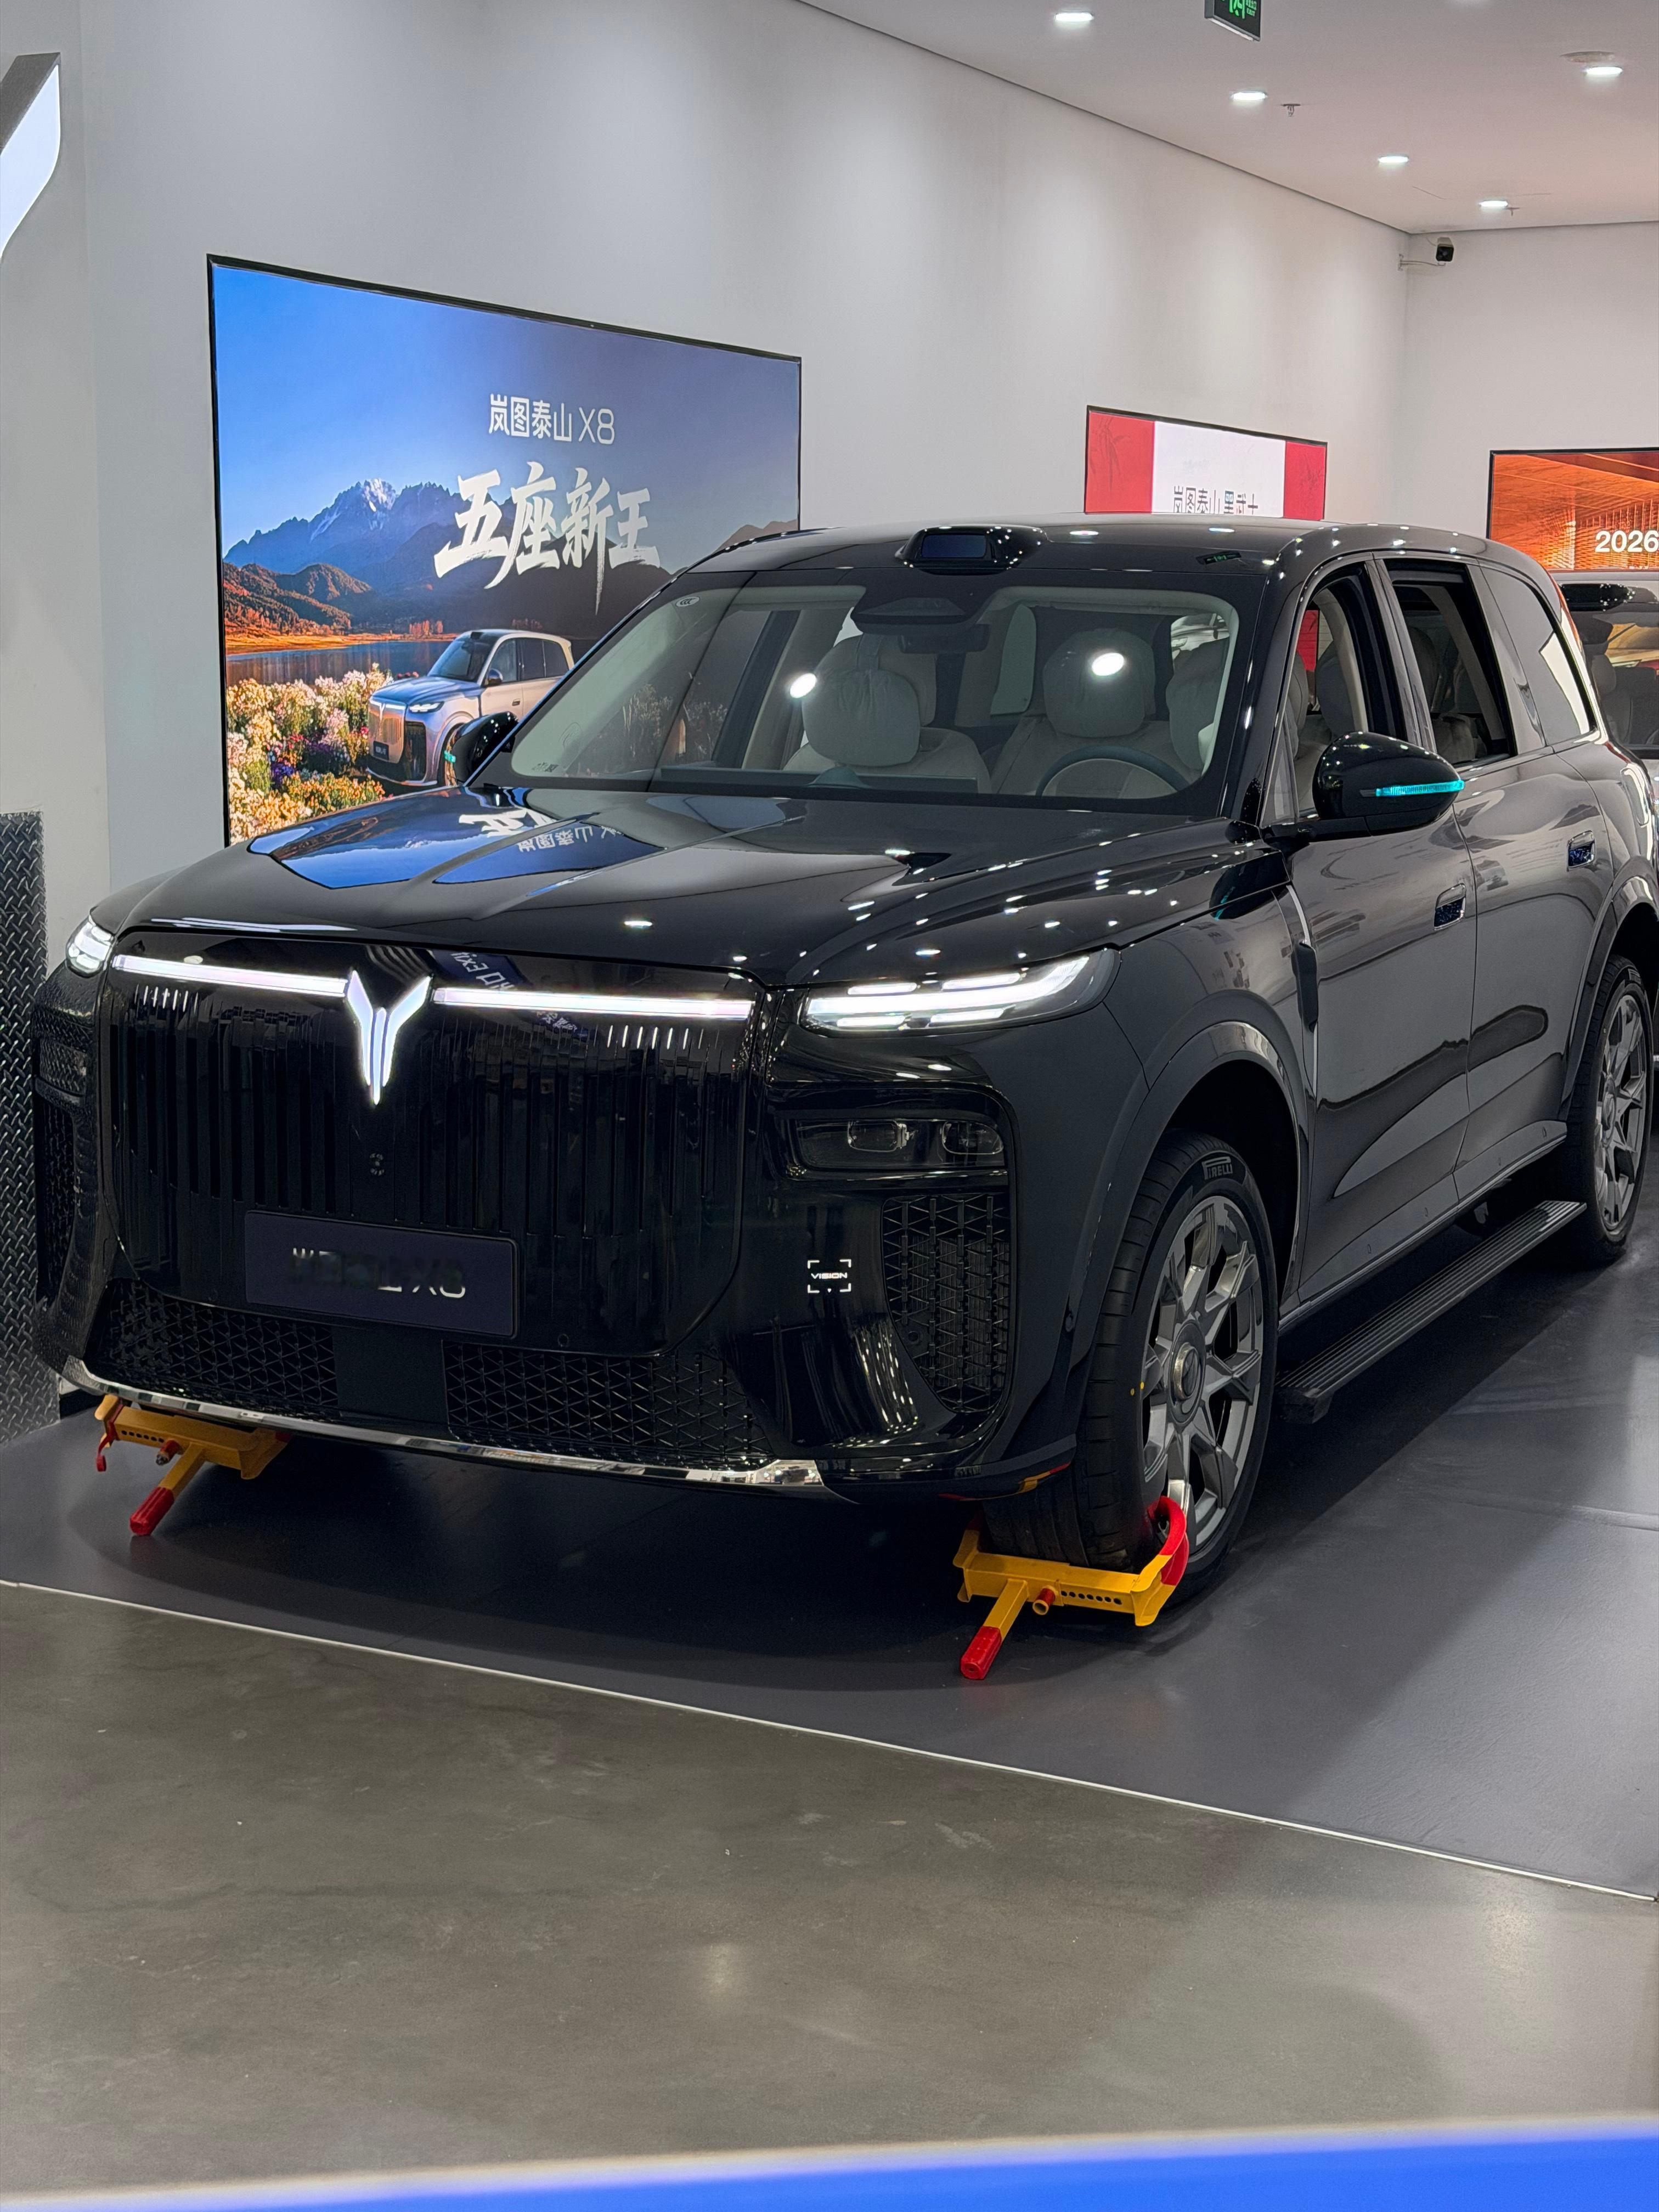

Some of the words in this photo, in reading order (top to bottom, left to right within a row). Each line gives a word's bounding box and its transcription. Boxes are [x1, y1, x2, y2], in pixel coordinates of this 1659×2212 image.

[488, 393, 572, 442] 岚图泰山
[578, 407, 614, 444] X8
[434, 461, 660, 616] 五座新王
[1595, 530, 1659, 553] 2026
[1201, 1156, 1233, 1180] PIRELLI
